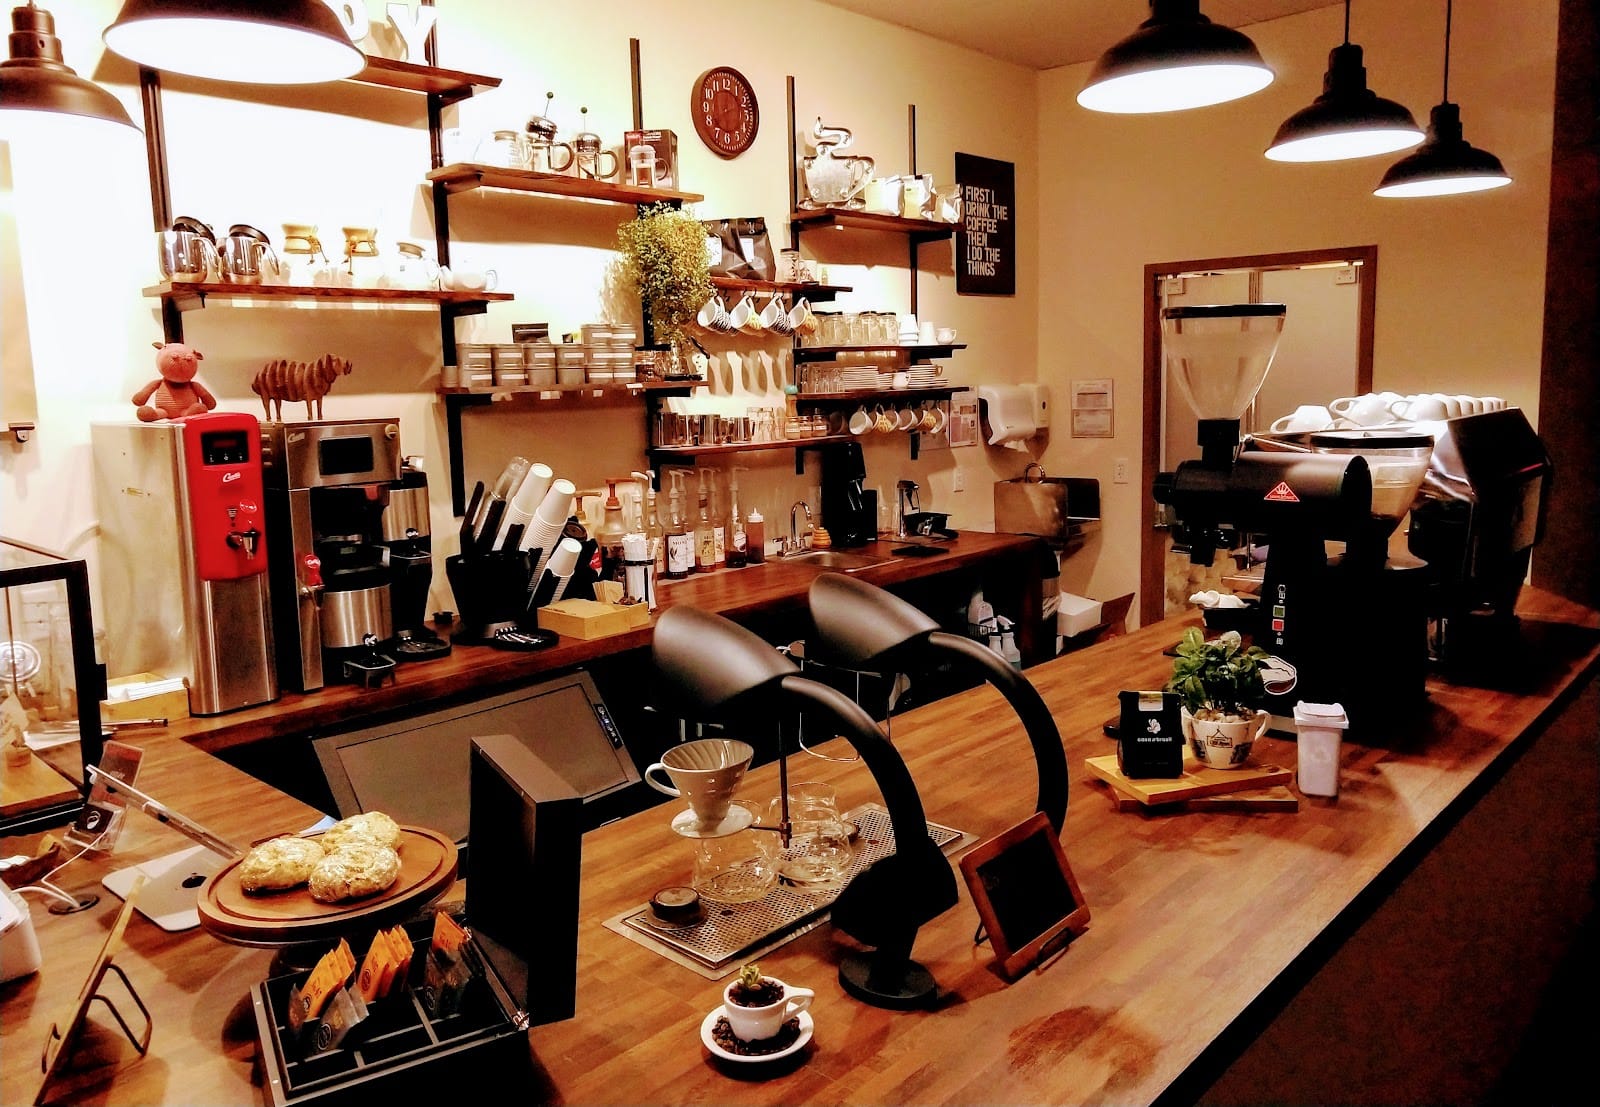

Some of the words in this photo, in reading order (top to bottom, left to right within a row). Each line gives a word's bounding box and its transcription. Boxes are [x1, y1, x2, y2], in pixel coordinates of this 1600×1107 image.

[712, 79, 720, 92] 11
[722, 78, 731, 90] 12
[705, 87, 714, 100] 10
[703, 101, 709, 113] 9
[741, 96, 746, 107] 2
[705, 114, 712, 126] 8
[744, 110, 749, 121] 3
[714, 127, 720, 139] 7
[741, 122, 746, 133] 4
[724, 132, 730, 144] 6
[734, 130, 740, 142] 5
[965, 185, 990, 203] FIRST
[965, 201, 990, 218] DRINK
[992, 204, 1008, 221] THE
[965, 216, 998, 233] COFFEE
[965, 231, 988, 247] THEN
[971, 246, 983, 261] DO
[984, 247, 1001, 263] THE
[966, 260, 996, 277] THINGS
